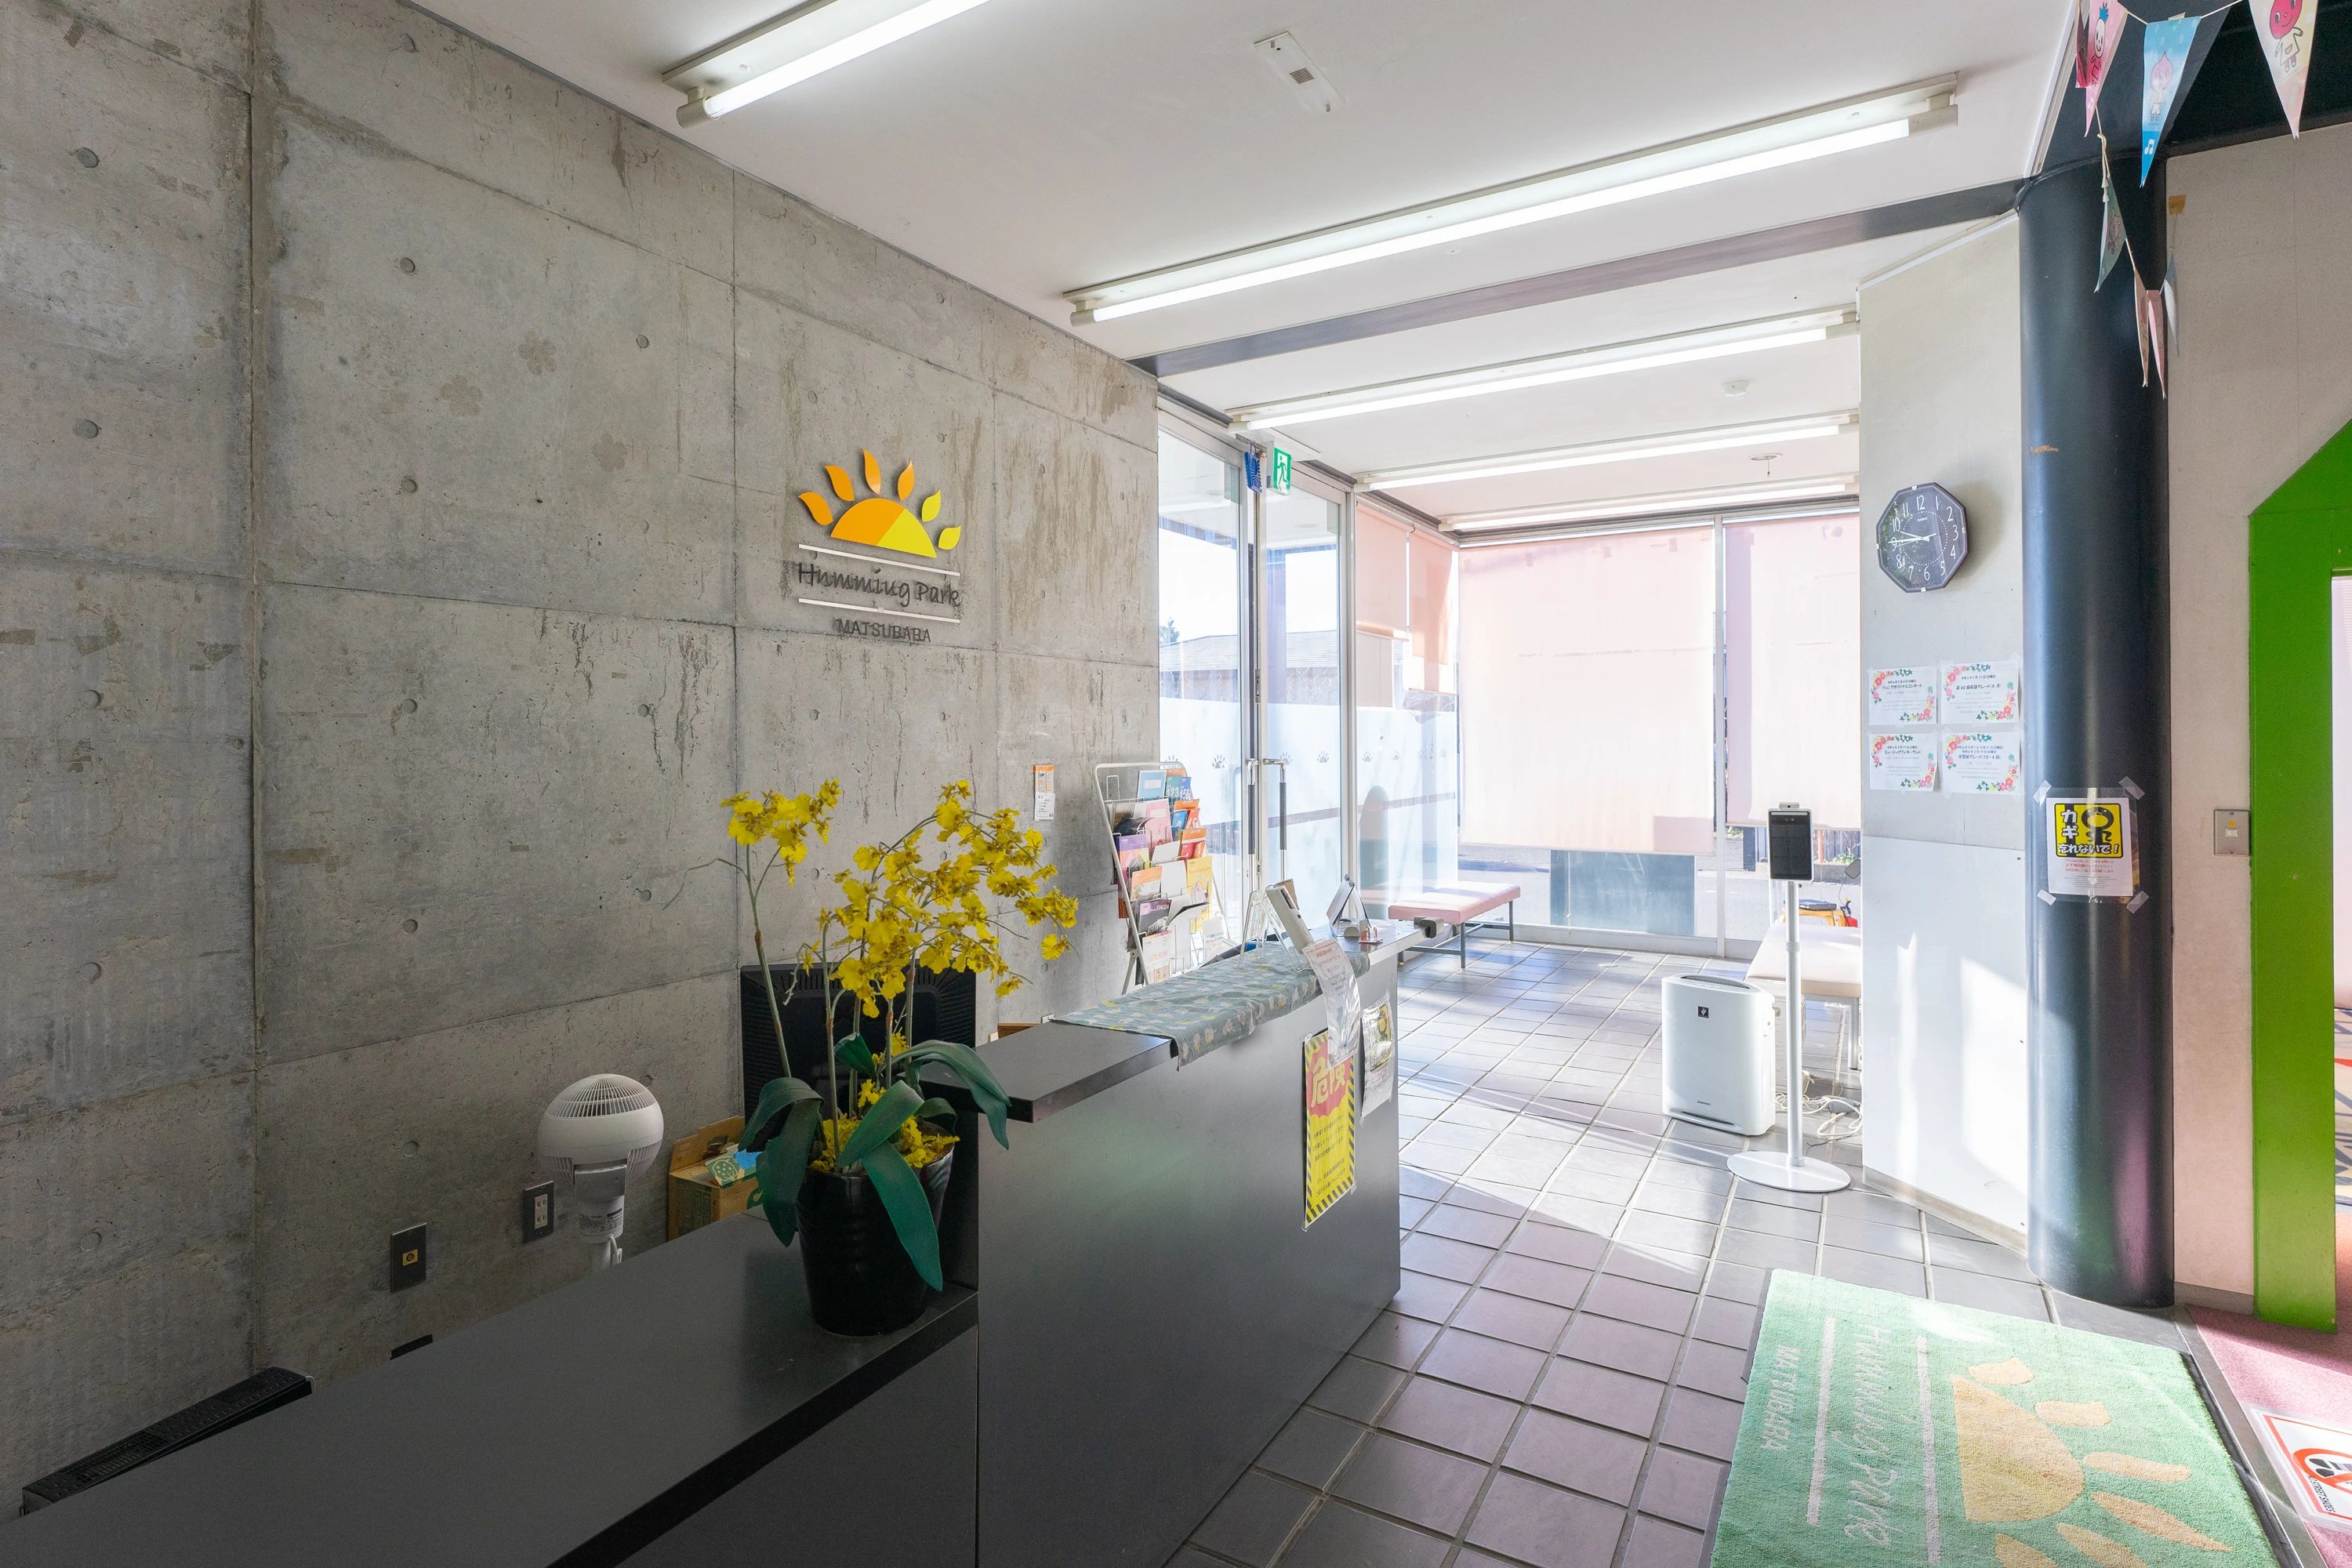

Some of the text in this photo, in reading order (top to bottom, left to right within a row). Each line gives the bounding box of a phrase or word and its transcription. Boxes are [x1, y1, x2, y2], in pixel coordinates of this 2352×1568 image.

[1902, 502, 1909, 517] 11
[1916, 495, 1926, 510] 12
[1935, 495, 1939, 510] 1
[1946, 506, 1954, 521] 2
[1892, 517, 1900, 532] 10
[1952, 524, 1958, 541] 3
[1890, 536, 1897, 552] 9
[1950, 544, 1956, 560] 4
[1896, 554, 1902, 569] 8
[1940, 561, 1946, 576] 5
[1908, 565, 1914, 581] 7
[1923, 565, 1930, 581] 6
[798, 561, 960, 608] Humming Park
[835, 618, 931, 642] MATSUBARA
[2060, 809, 2079, 840] カギ
[1843, 1461, 1905, 1546] Park
